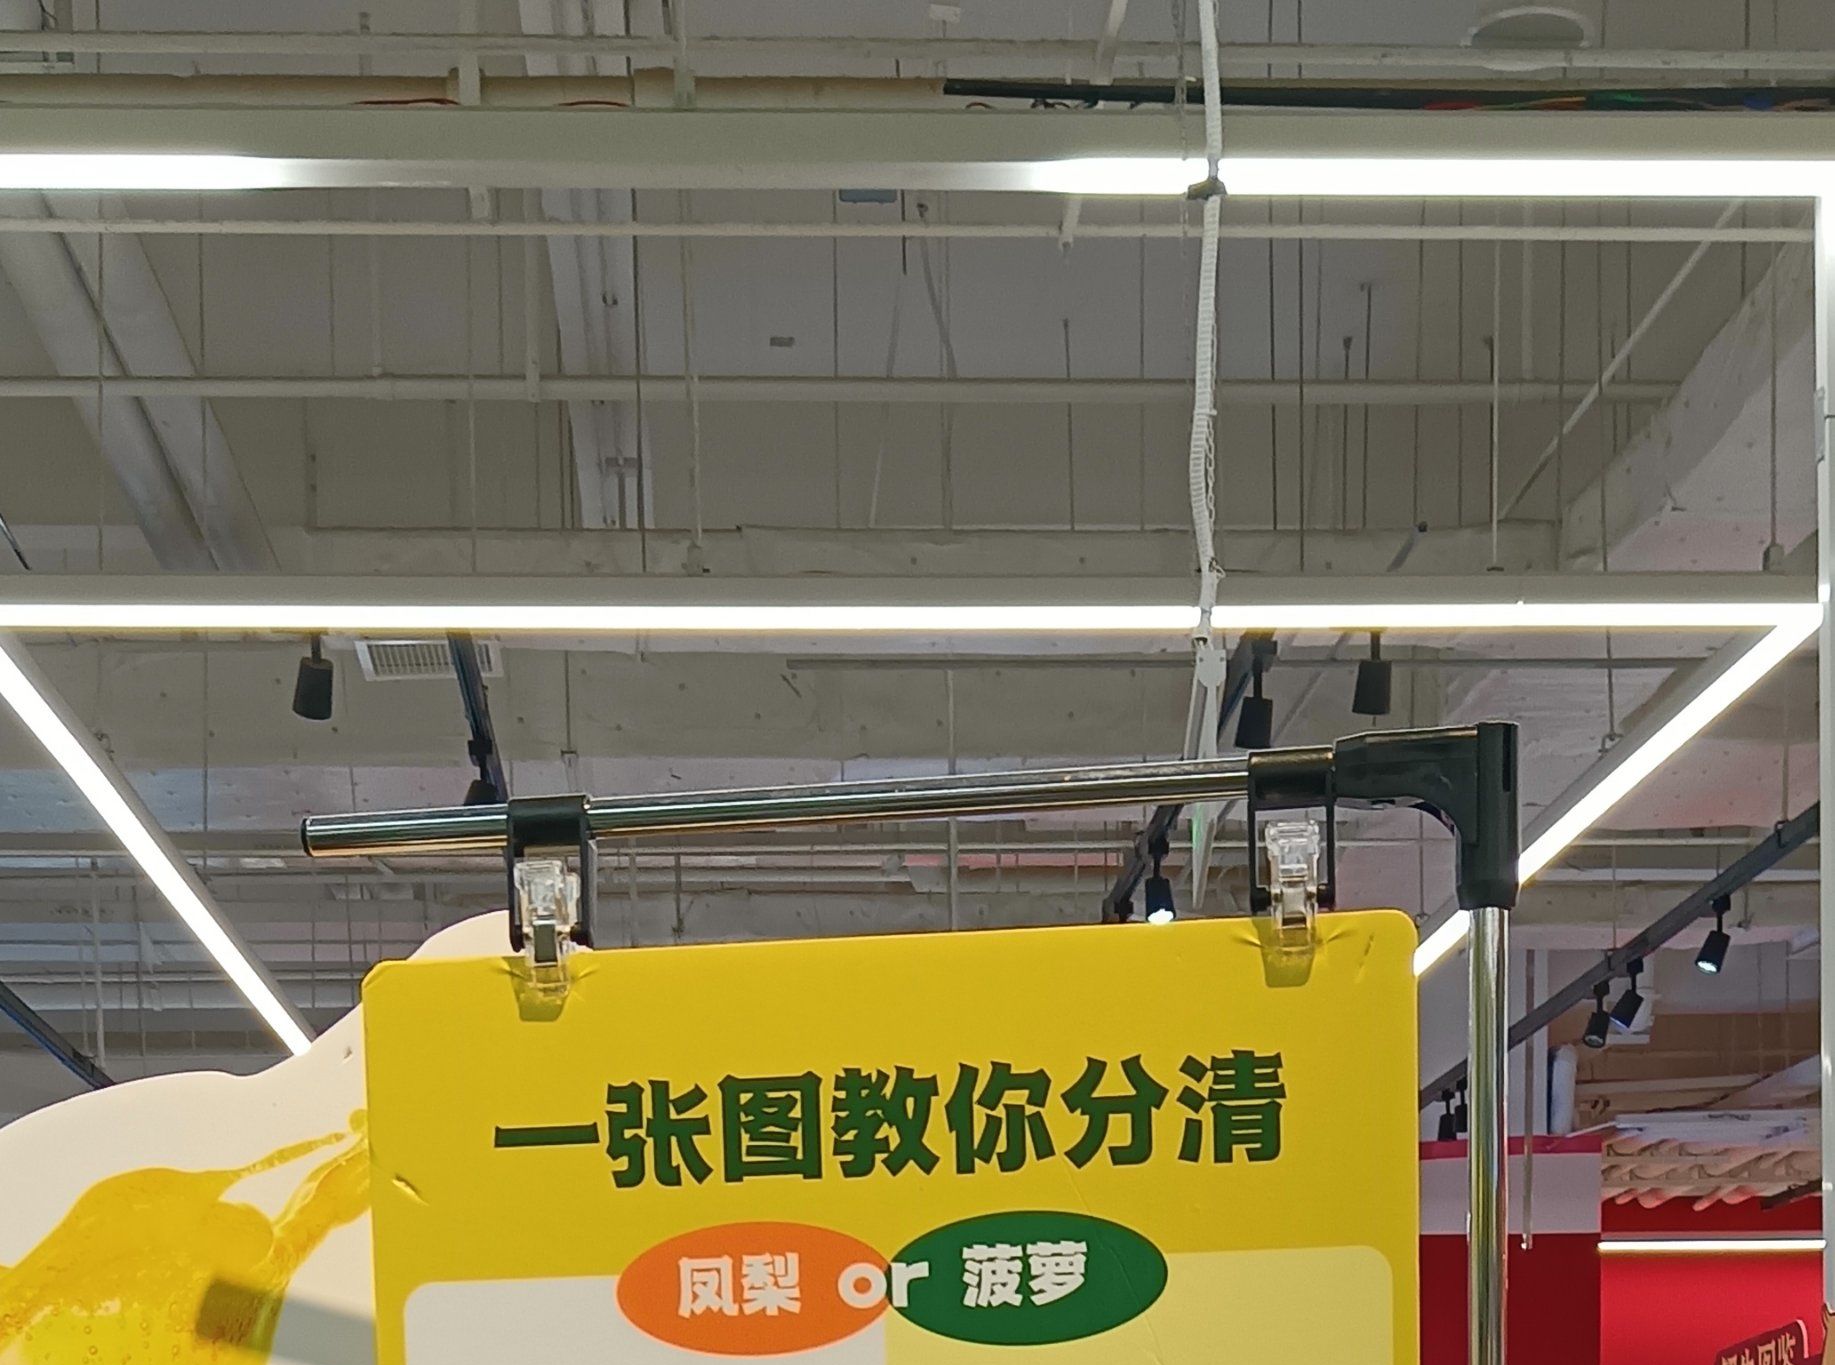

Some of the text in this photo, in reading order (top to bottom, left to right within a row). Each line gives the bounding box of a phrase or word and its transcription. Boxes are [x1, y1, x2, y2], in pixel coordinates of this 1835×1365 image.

[493, 1048, 1288, 1189] 一张图教你分清
[677, 1239, 1089, 1318] 凤梨 or 菠萝
